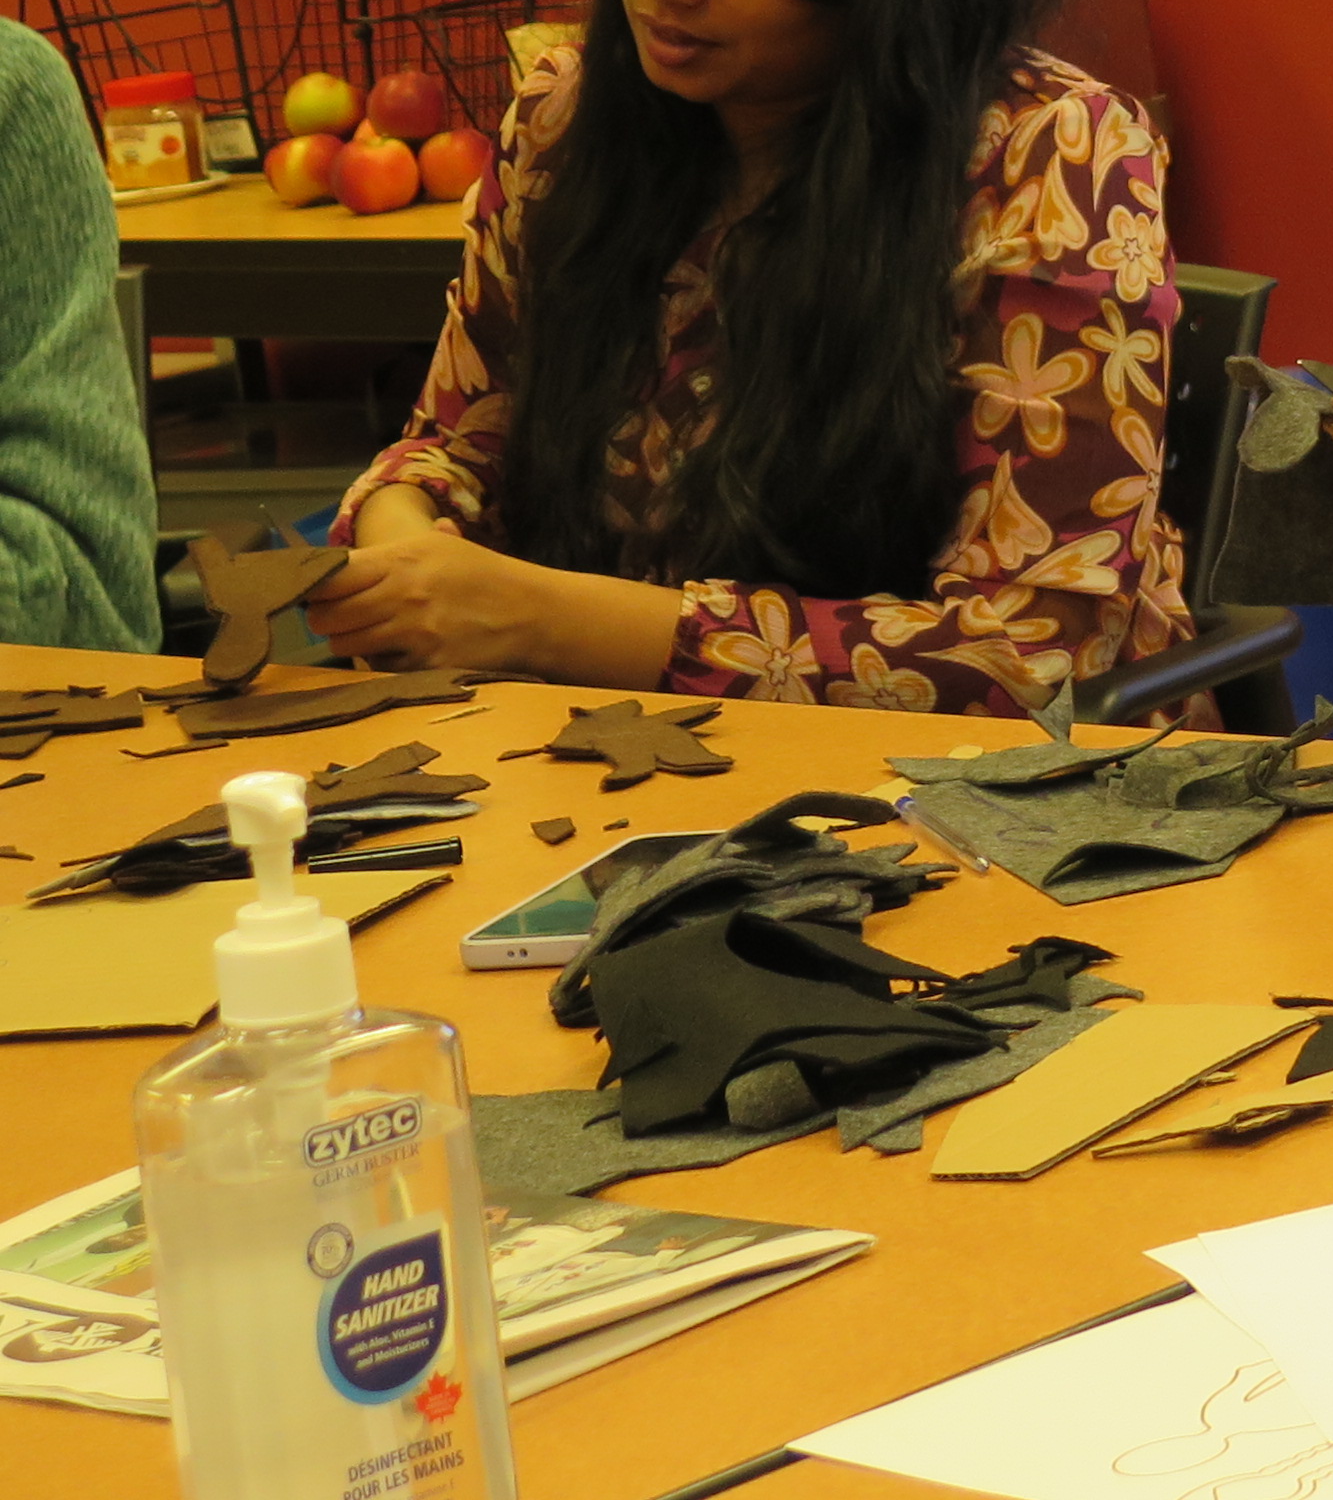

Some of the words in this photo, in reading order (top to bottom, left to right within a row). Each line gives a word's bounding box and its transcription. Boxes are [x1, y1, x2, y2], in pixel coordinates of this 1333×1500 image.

[312, 1106, 415, 1162] zytec
[313, 1163, 360, 1188] GERM
[364, 1142, 420, 1172] BUSTER
[363, 1259, 425, 1300] HAND
[334, 1284, 440, 1341] SANITIZER
[391, 1322, 427, 1342] Vitamin
[355, 1353, 374, 1370] and
[374, 1337, 430, 1363] Moisturizers
[342, 1479, 381, 1500] POUR
[384, 1468, 410, 1491] LES
[412, 1449, 465, 1481] MAINS
